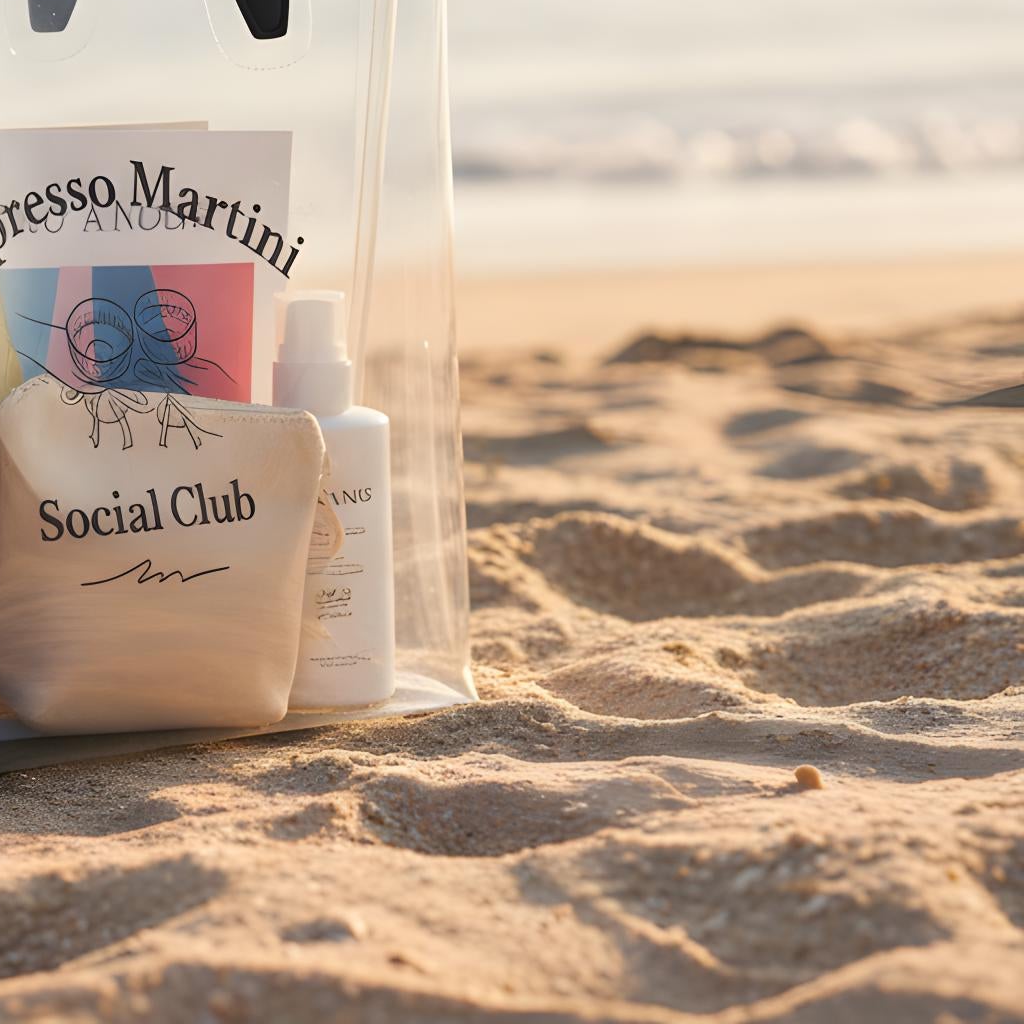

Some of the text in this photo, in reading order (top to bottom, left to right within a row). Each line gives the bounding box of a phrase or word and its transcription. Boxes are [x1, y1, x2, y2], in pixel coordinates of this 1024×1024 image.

[129, 160, 306, 279] Martini
[39, 478, 256, 542] Social Club
